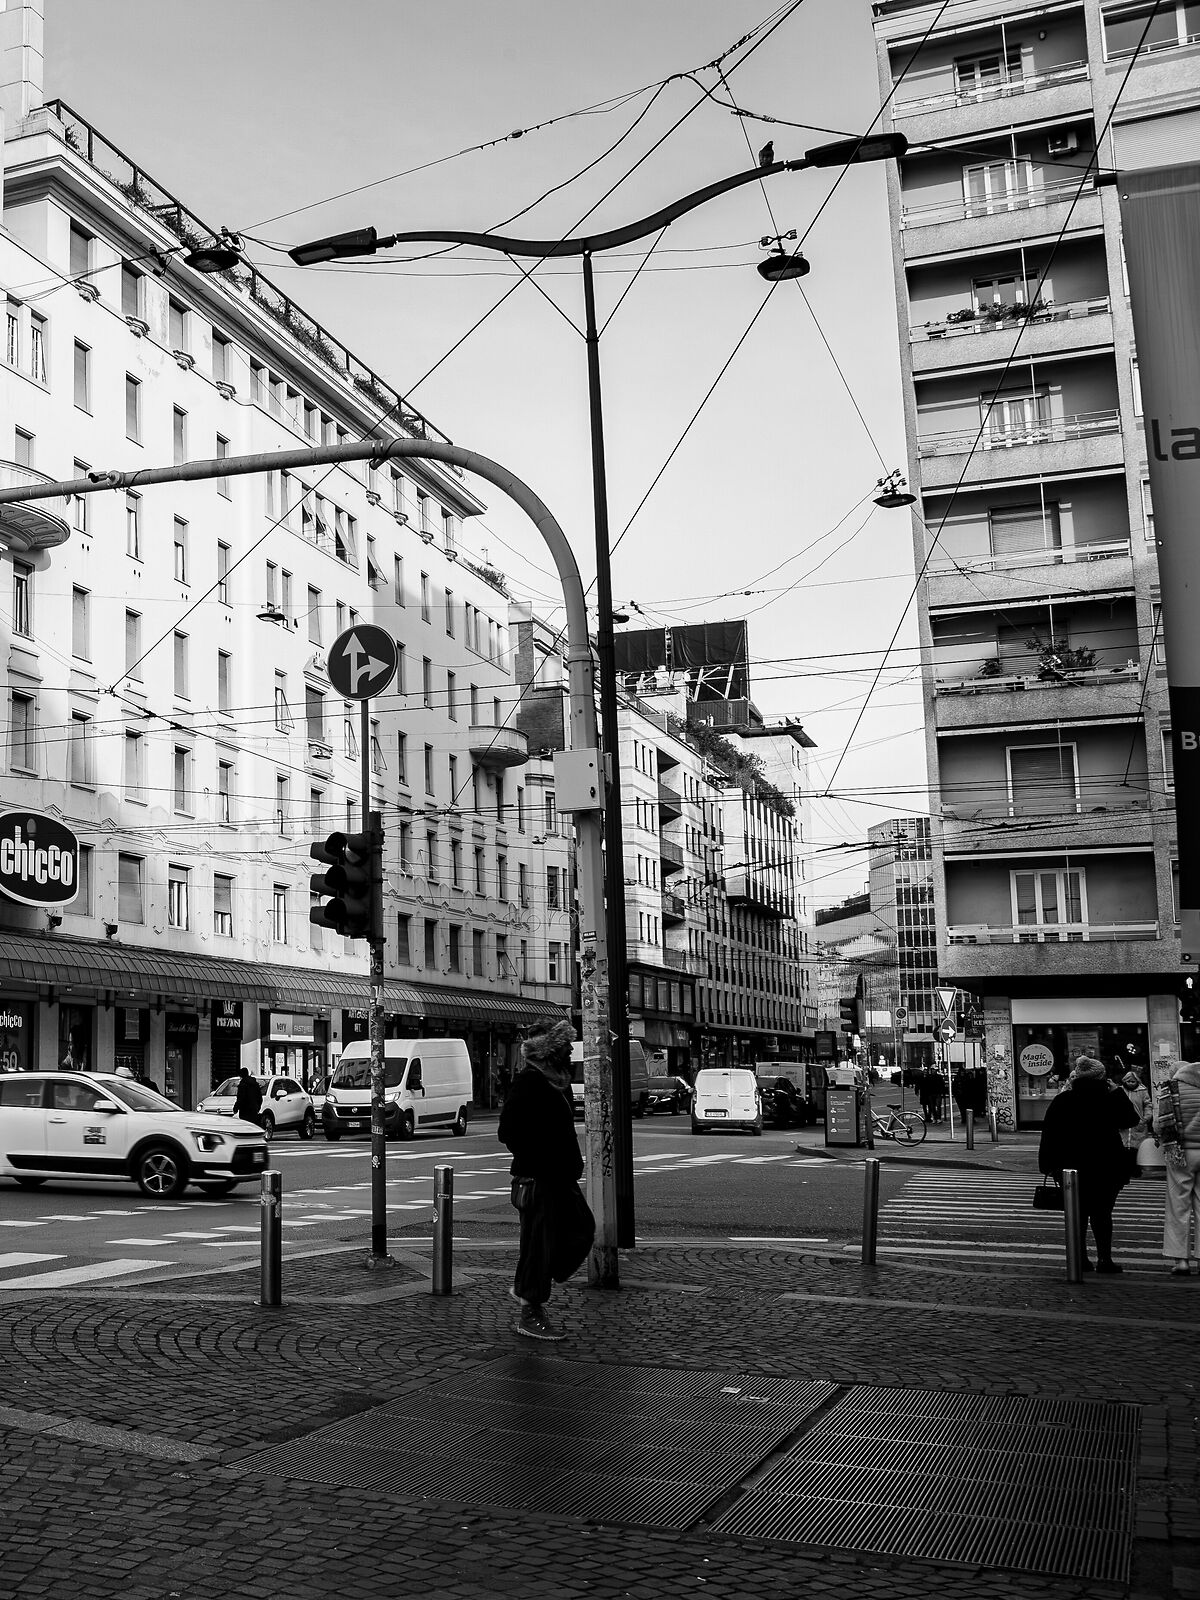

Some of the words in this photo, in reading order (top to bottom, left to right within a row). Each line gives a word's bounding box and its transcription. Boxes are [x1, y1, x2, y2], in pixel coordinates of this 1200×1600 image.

[1181, 731, 1200, 750] B
[0, 818, 73, 886] chicco
[0, 1009, 23, 1029] chicco
[1022, 1052, 1047, 1062] Magic
[1027, 1059, 1053, 1068] inside
